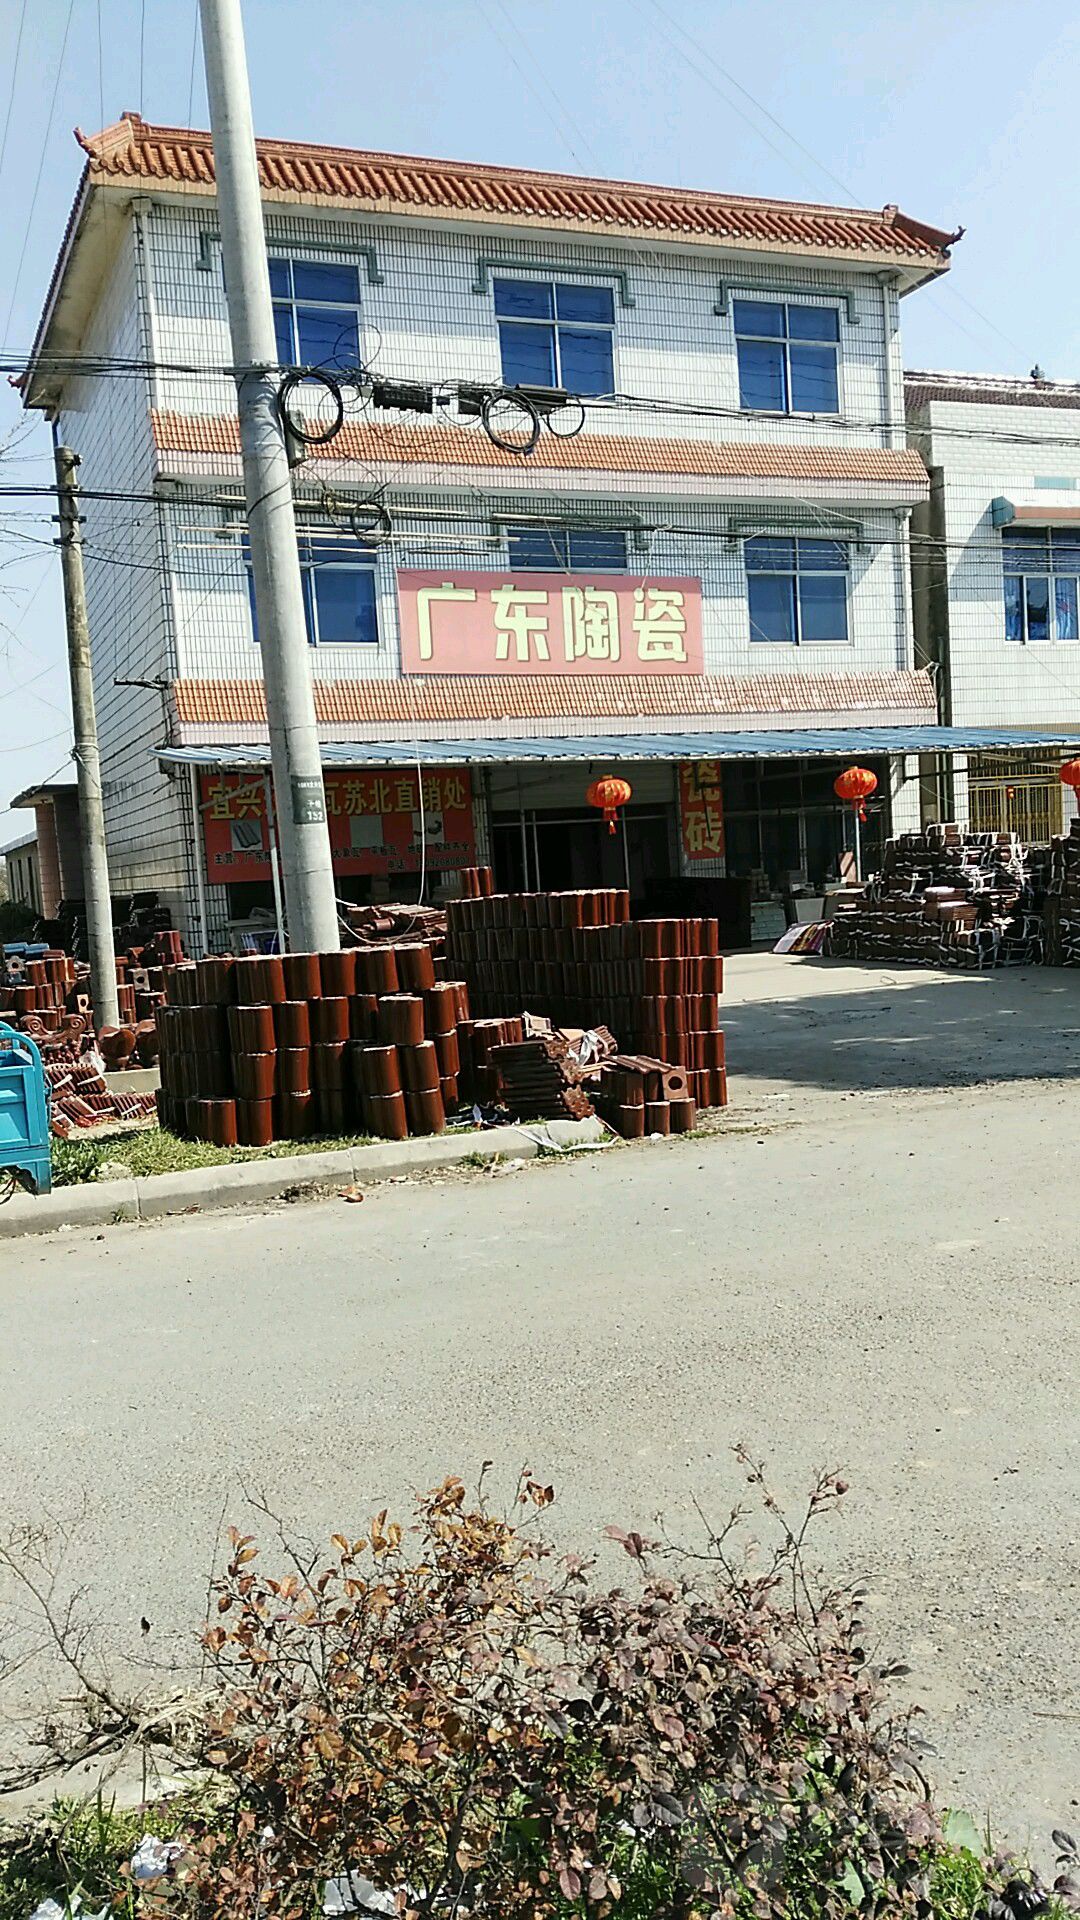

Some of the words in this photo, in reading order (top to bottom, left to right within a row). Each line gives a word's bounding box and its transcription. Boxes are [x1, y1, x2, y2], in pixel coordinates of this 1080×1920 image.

[417, 582, 688, 662] 广东陶瓷
[208, 777, 466, 820] 宜兴瓦苏北直销处
